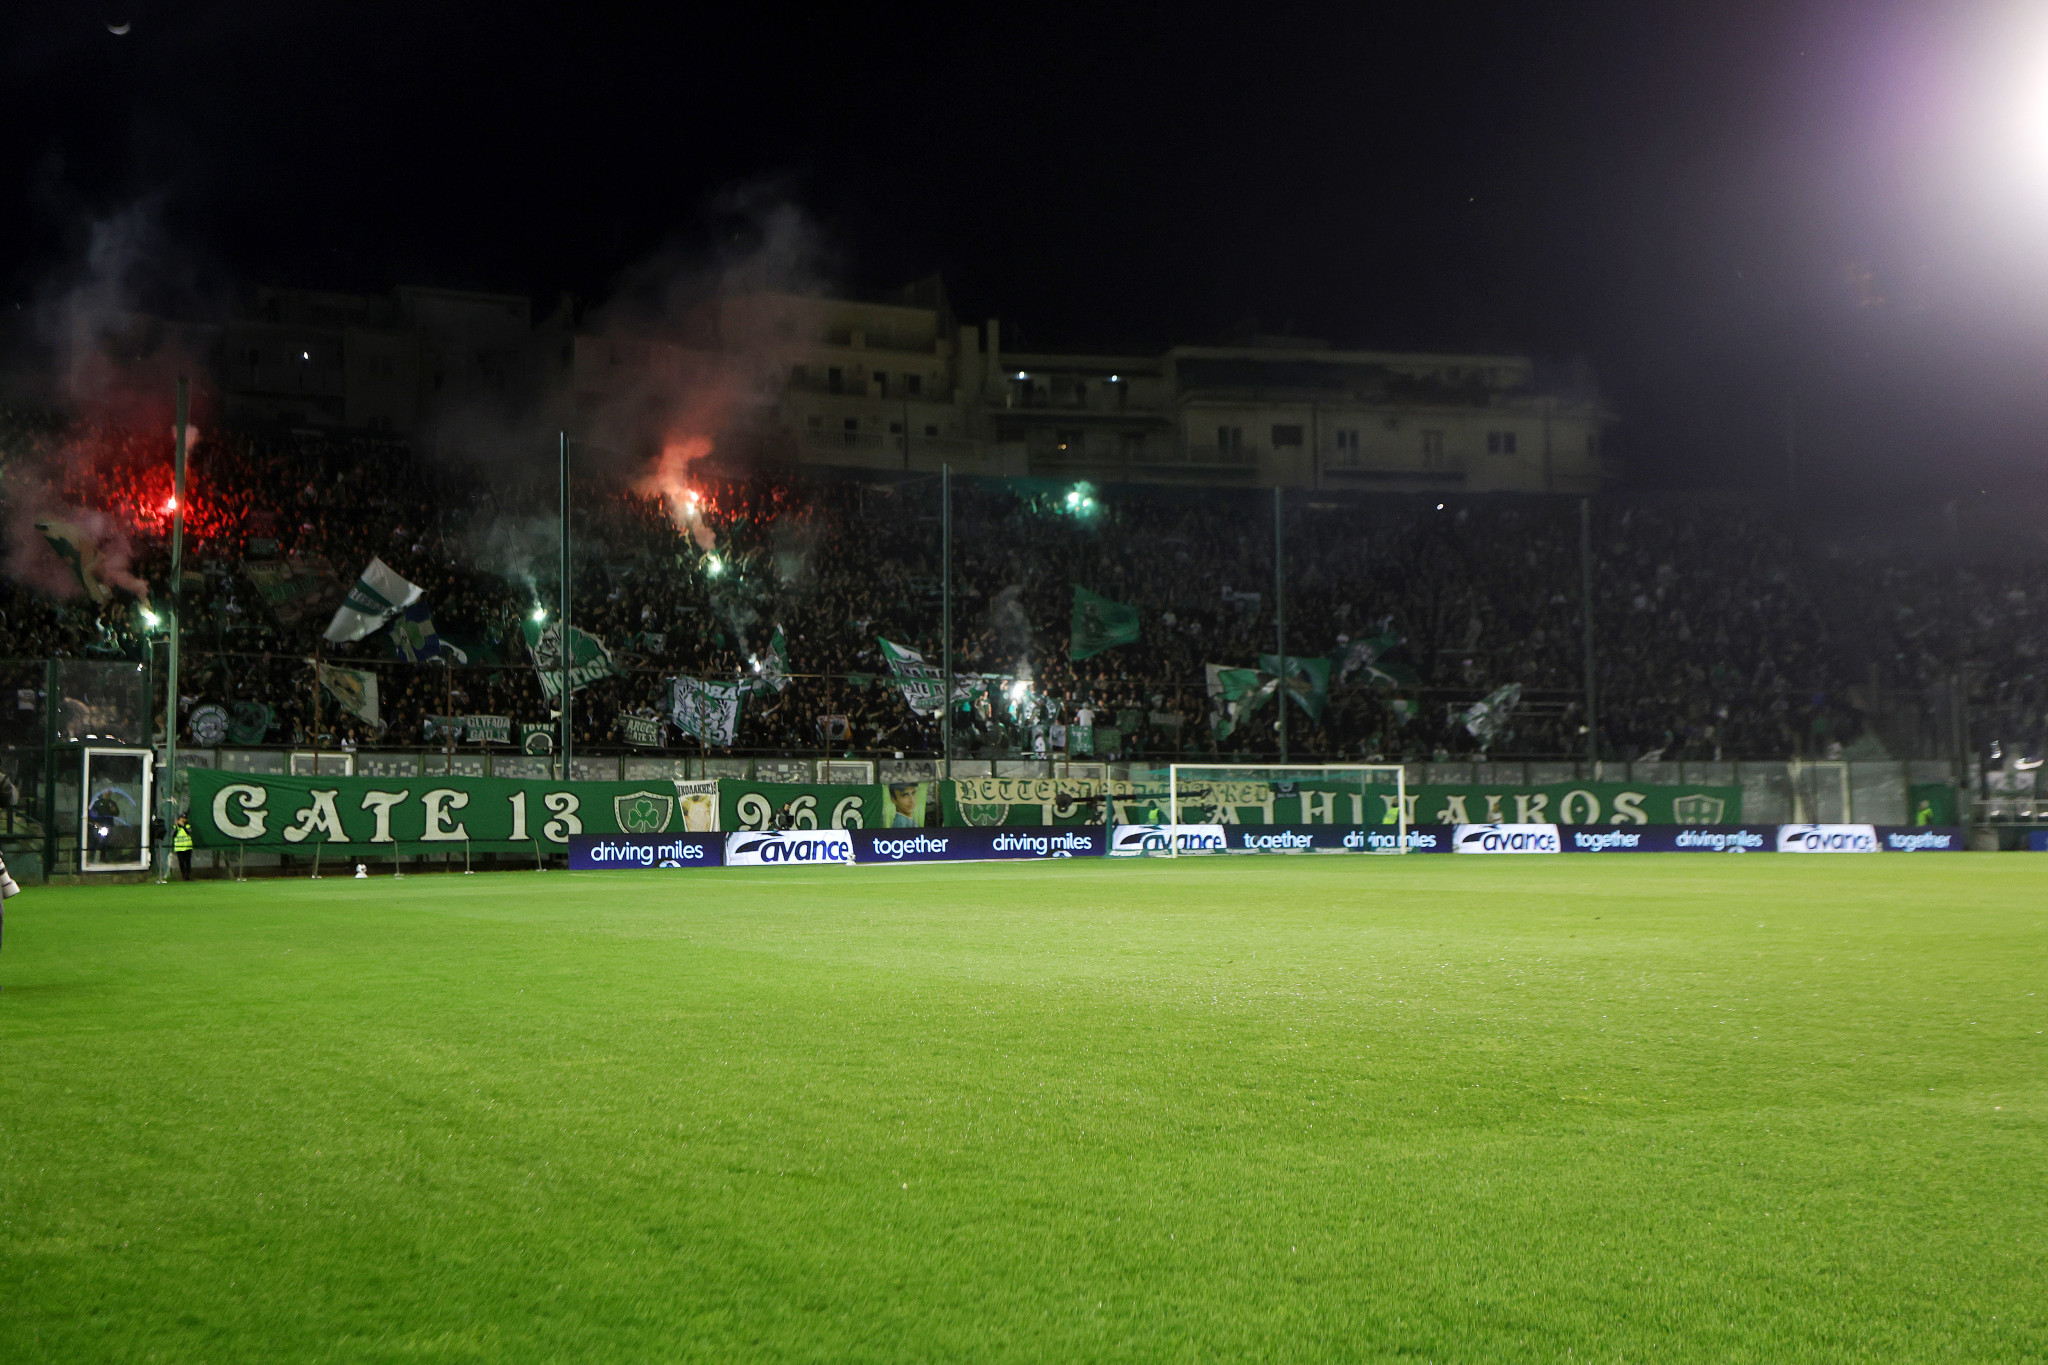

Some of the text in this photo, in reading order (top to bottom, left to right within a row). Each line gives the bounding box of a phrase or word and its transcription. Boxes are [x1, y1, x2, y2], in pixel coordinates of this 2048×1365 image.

[960, 780, 1070, 801] BETTER
[1225, 782, 1269, 803] RED
[212, 784, 583, 844] GATE 13
[759, 838, 849, 863] avance
[873, 834, 948, 859] together
[993, 832, 1092, 856] driving miles
[1143, 833, 1222, 850] avance
[1484, 832, 1558, 851] avance
[1575, 830, 1641, 852] together
[1675, 829, 1764, 851] driving miles
[1804, 832, 1876, 851] avance
[1888, 831, 1952, 852] together
[591, 840, 704, 866] driving miles
